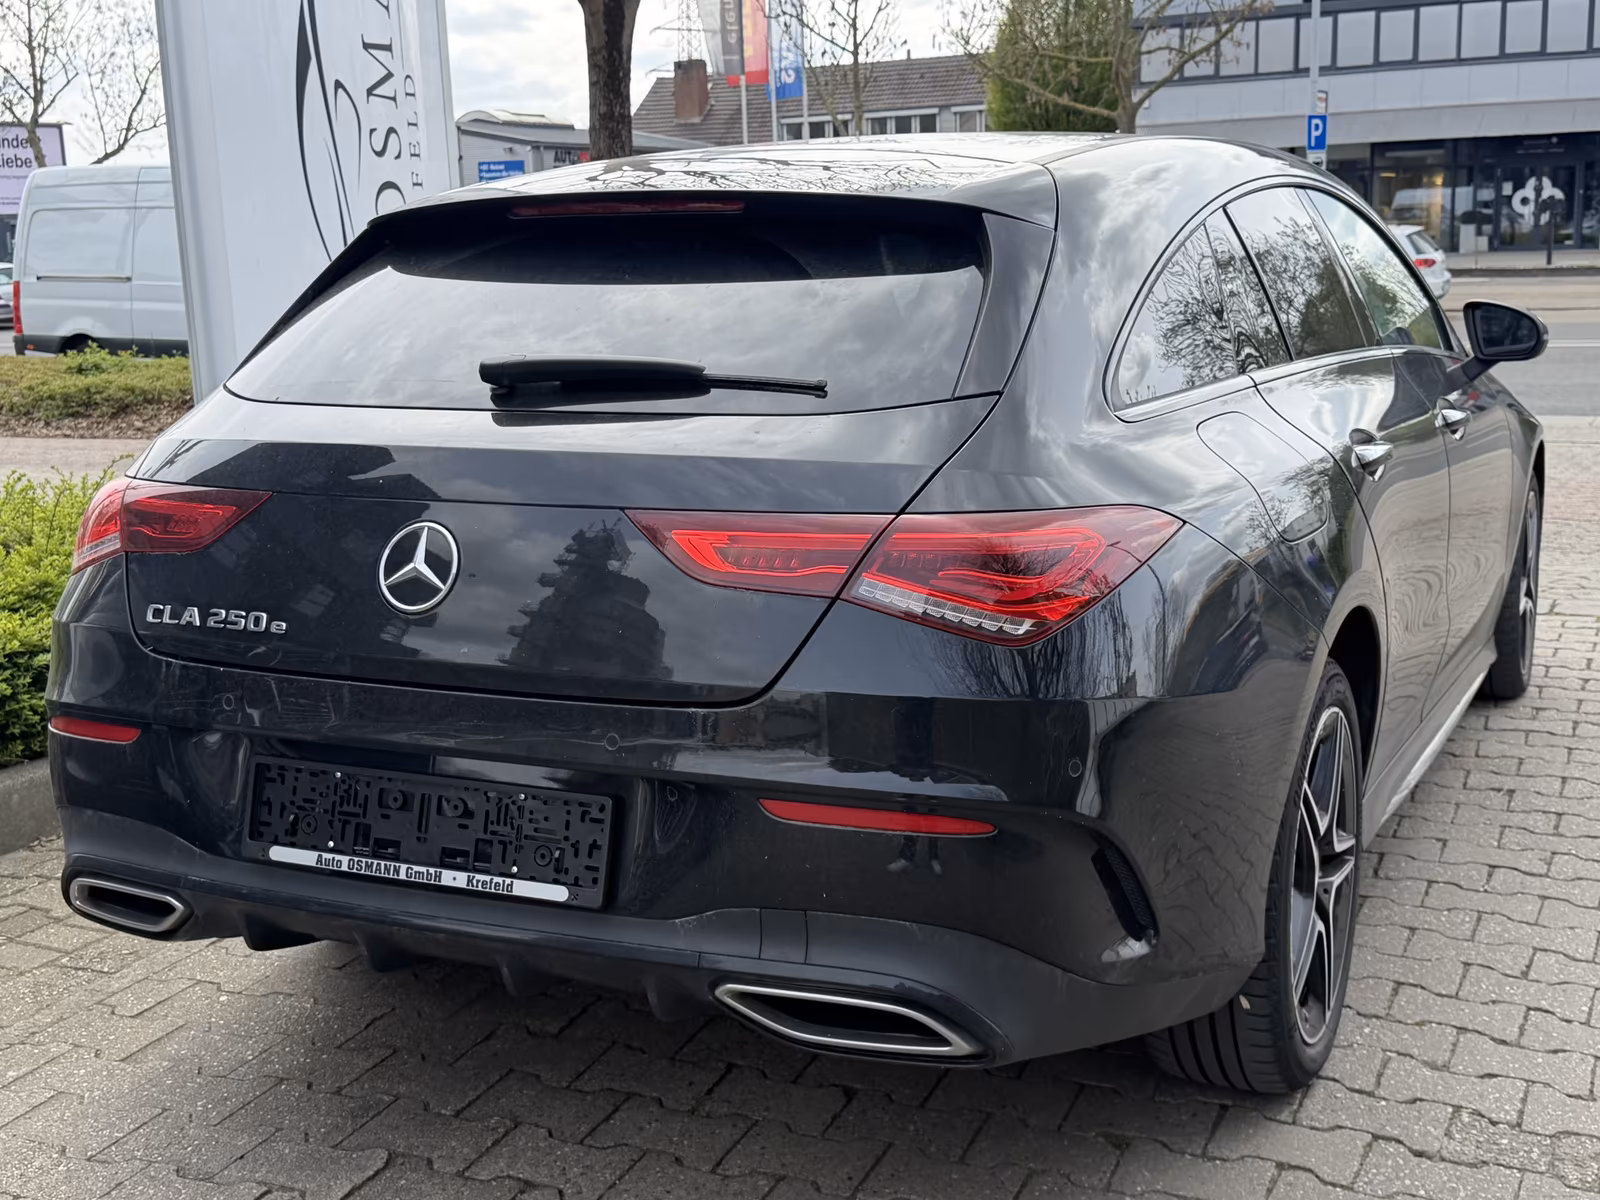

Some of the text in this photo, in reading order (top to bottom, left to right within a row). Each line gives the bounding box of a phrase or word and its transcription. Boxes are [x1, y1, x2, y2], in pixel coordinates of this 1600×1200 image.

[1310, 118, 1323, 147] P
[0, 153, 33, 168] iebe
[146, 604, 200, 627] CLA
[315, 854, 514, 893] Auto OSMANN GmbH Krefeld
